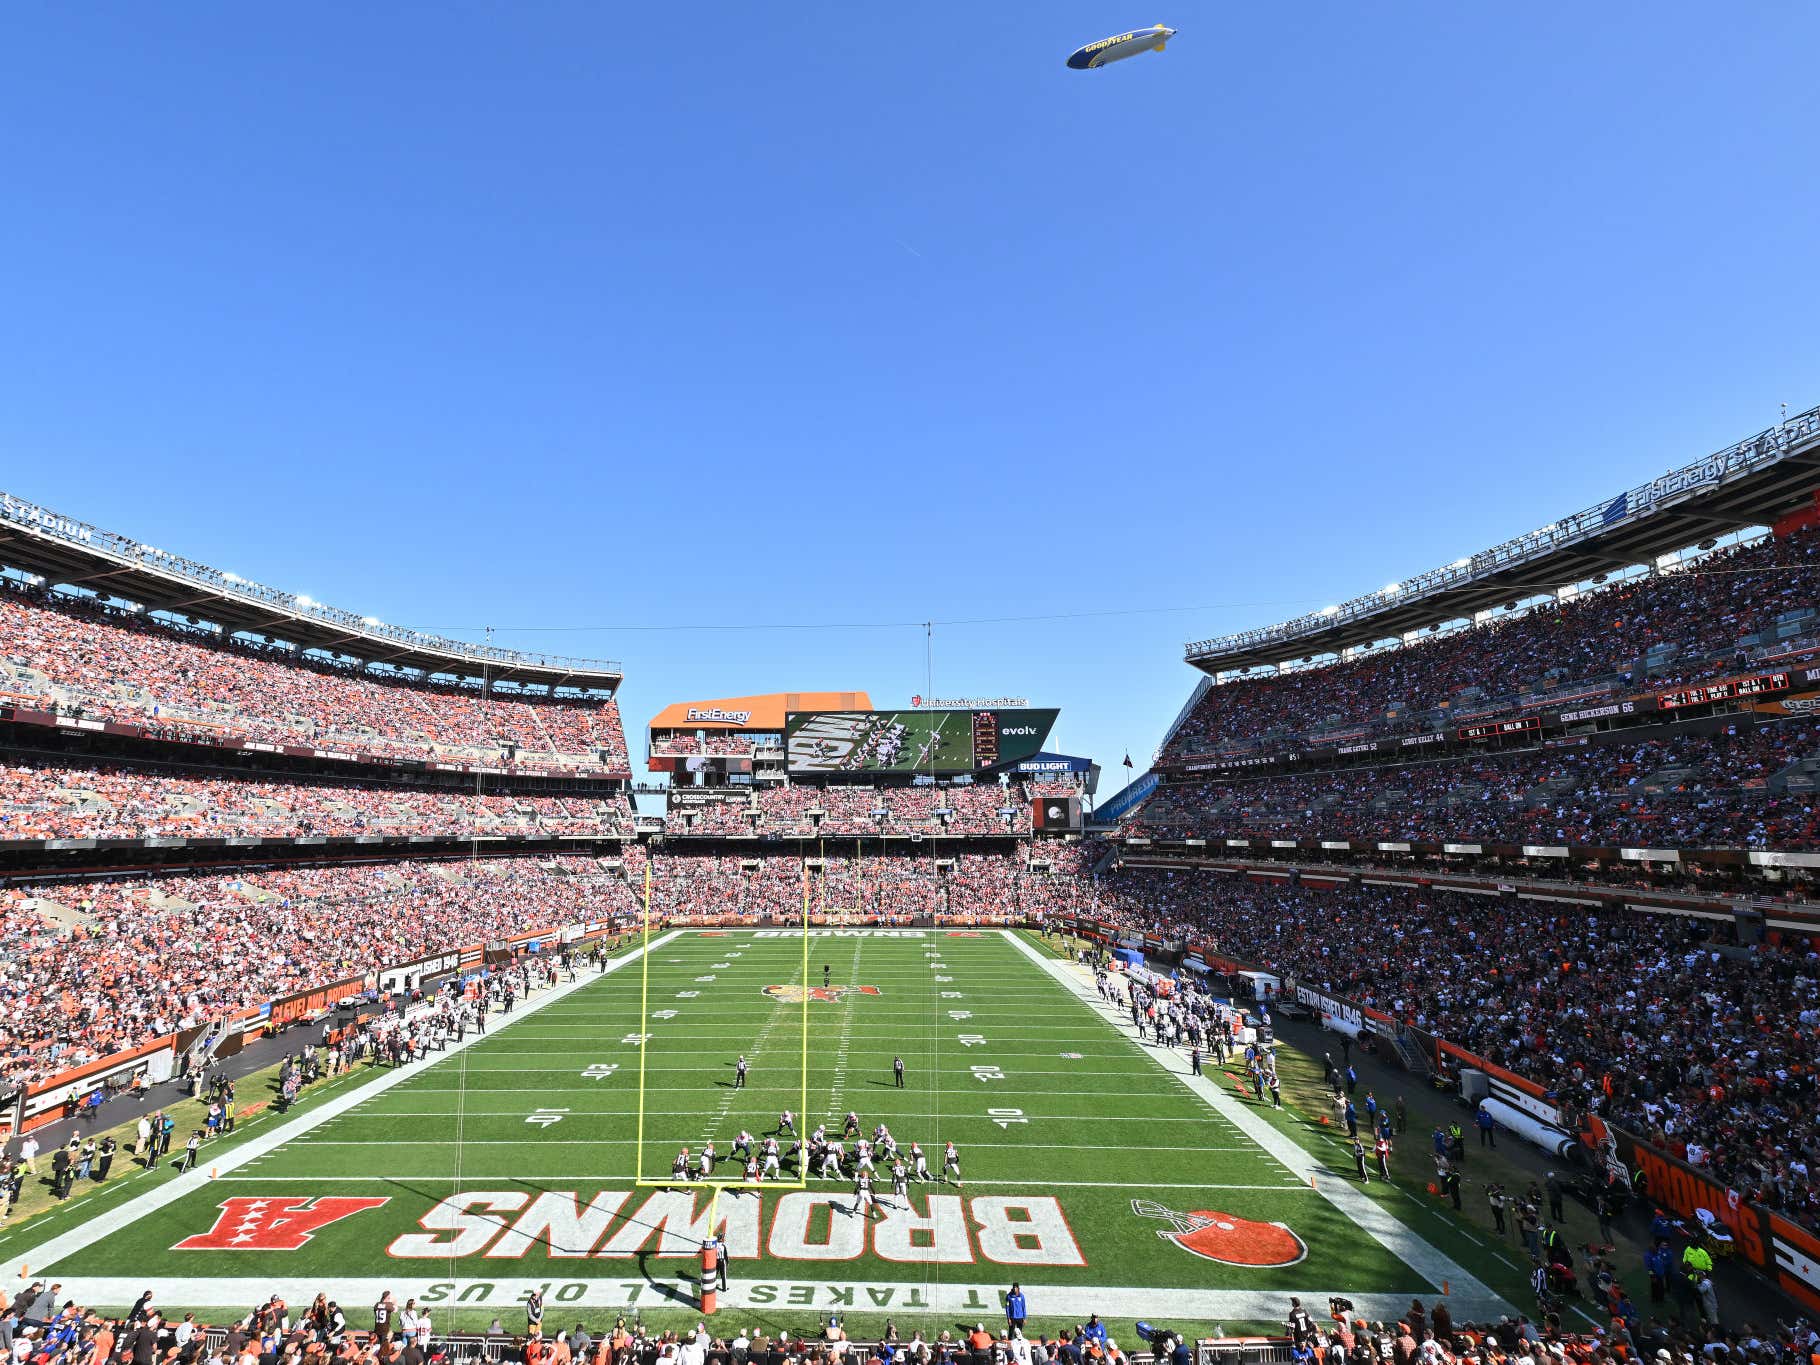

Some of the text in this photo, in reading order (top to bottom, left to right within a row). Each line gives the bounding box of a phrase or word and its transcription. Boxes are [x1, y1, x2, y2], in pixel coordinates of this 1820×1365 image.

[1085, 33, 1133, 53] GOODYEAR
[1627, 413, 1820, 508] FirstEnergy STADI
[4, 494, 91, 541] STADIUM
[921, 697, 1028, 708] University Hospitals
[1622, 702, 1634, 713] 66
[687, 708, 752, 722] FirstEnergy
[1002, 726, 1037, 735] evolv
[1020, 762, 1069, 771] BUD LIGHT
[580, 1064, 619, 1077] 20
[525, 1108, 571, 1123] 10
[987, 1108, 1029, 1123] 10
[387, 1191, 1088, 1266] BROWNS
[419, 1283, 495, 1301] US
[750, 1284, 929, 1308] TAKES
[376, 1310, 387, 1324] 19
[1019, 1346, 1027, 1360] 4
[1381, 1343, 1393, 1358] 95
